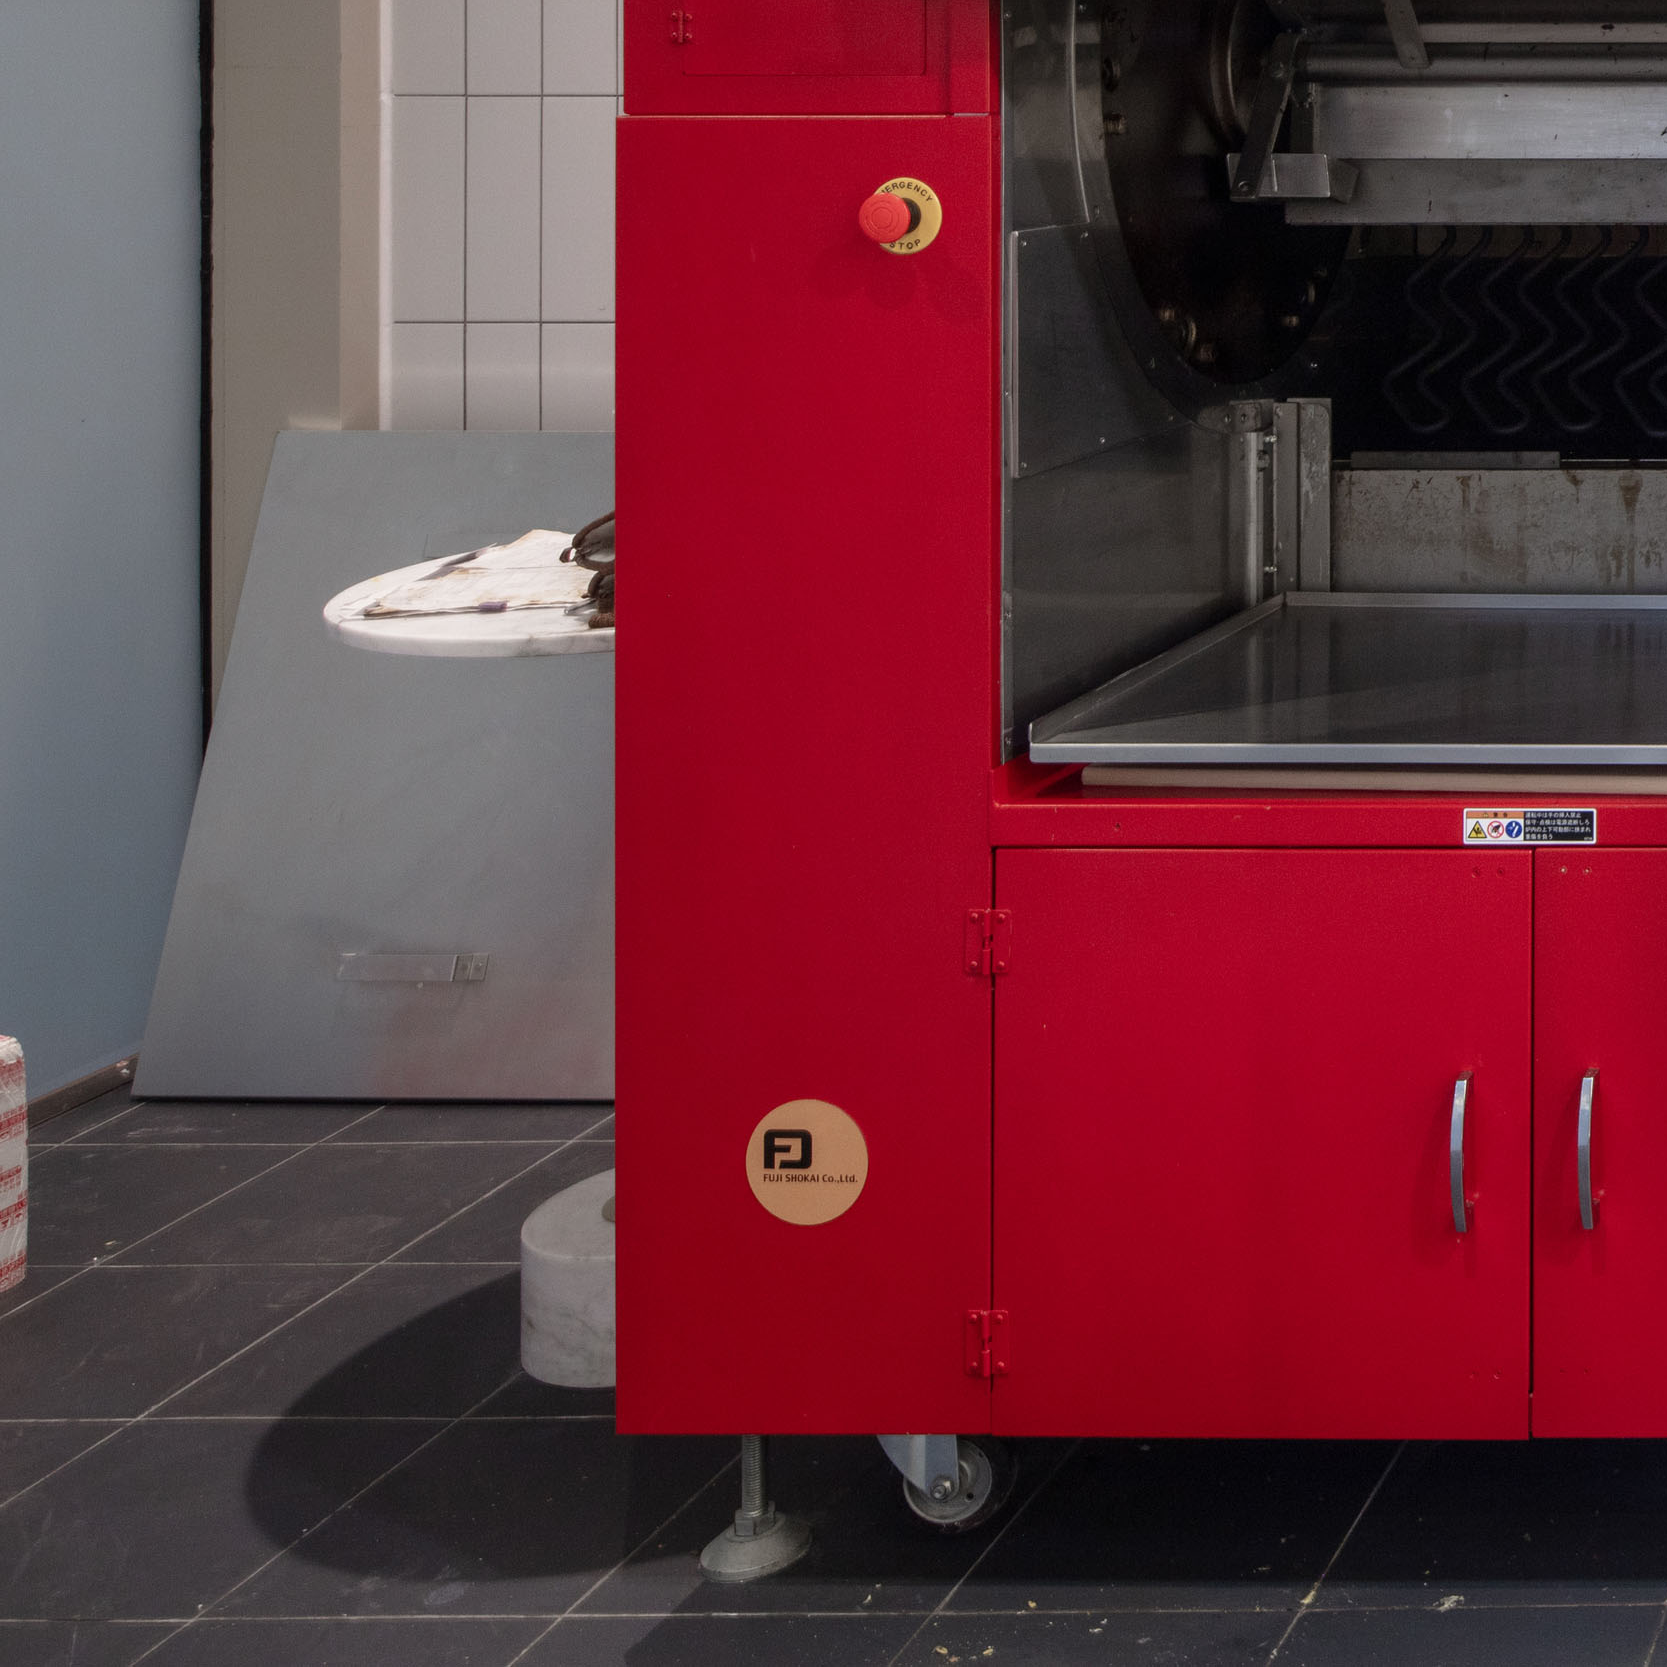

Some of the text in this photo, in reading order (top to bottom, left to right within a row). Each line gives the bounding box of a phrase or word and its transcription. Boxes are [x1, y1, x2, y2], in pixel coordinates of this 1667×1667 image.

[880, 181, 933, 203] ERGENCY
[889, 238, 921, 250] STOP
[763, 1174, 783, 1183] FUJI
[785, 1174, 819, 1183] SHOKAI
